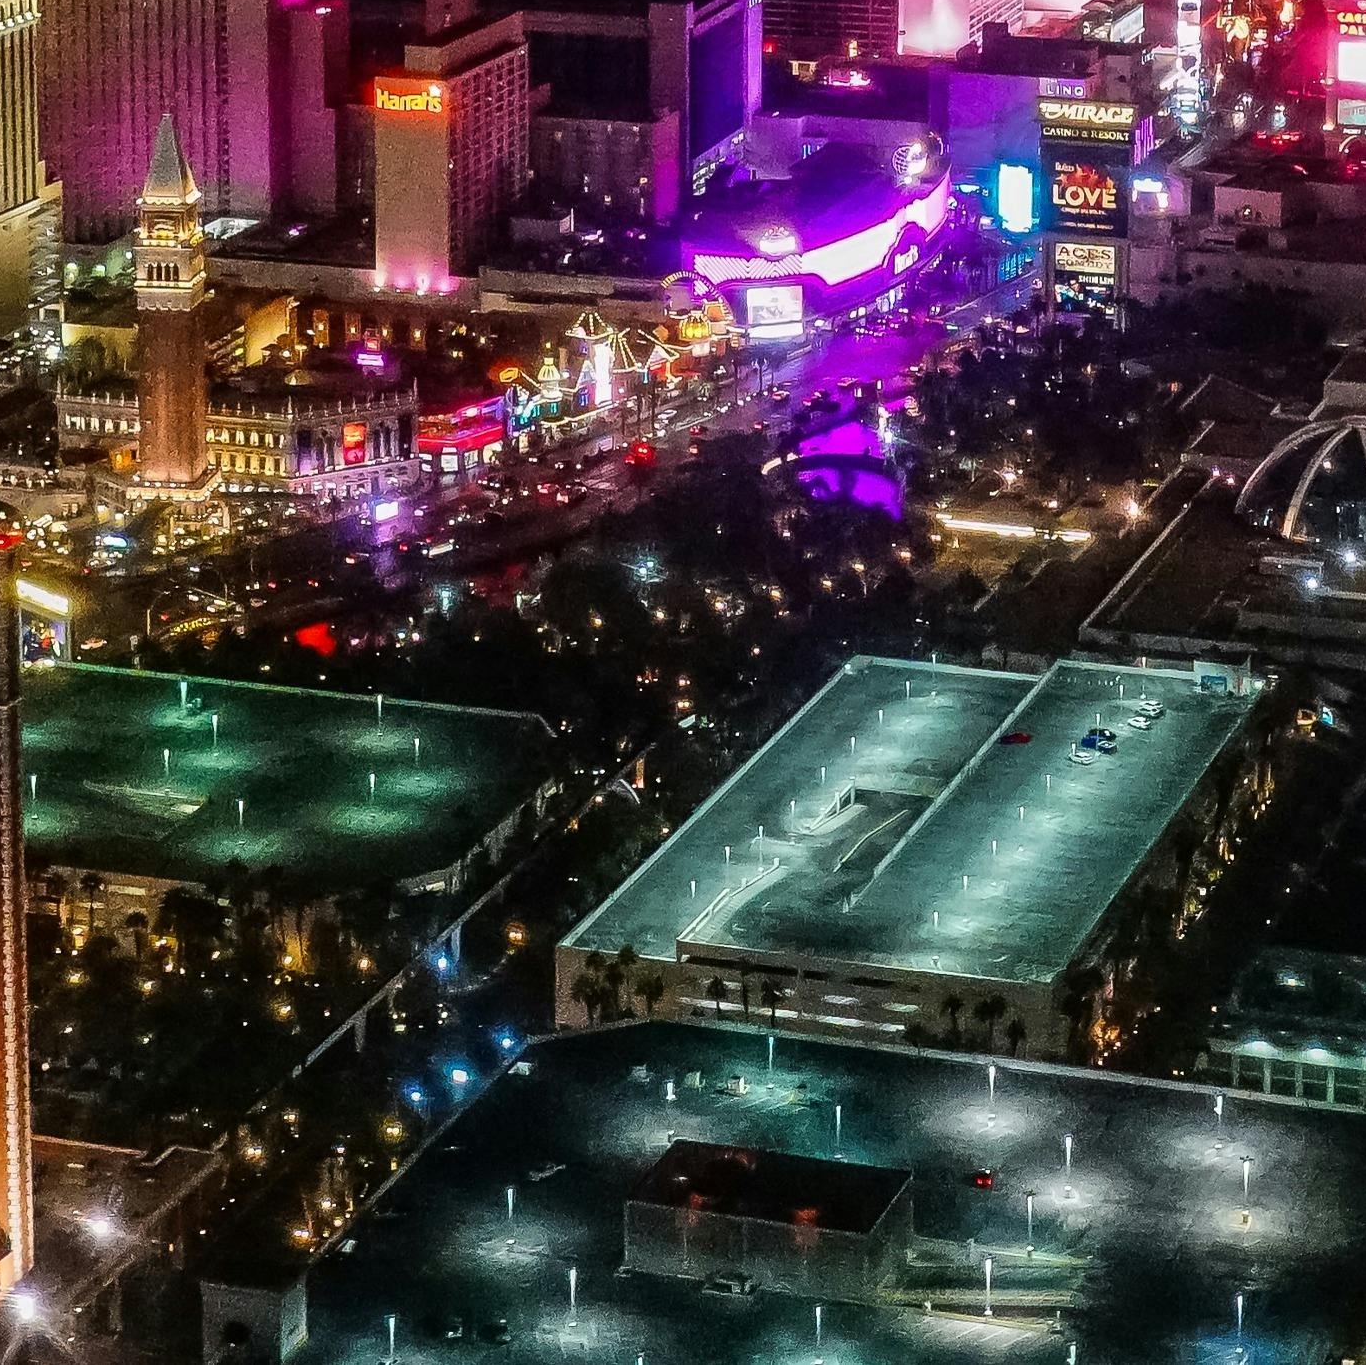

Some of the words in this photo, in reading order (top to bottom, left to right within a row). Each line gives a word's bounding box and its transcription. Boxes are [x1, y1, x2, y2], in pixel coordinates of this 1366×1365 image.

[1047, 85, 1085, 96] LINQ
[1044, 104, 1134, 124] MIRAGE
[1091, 131, 1130, 142] RESORT
[1052, 184, 1117, 209] LOVE
